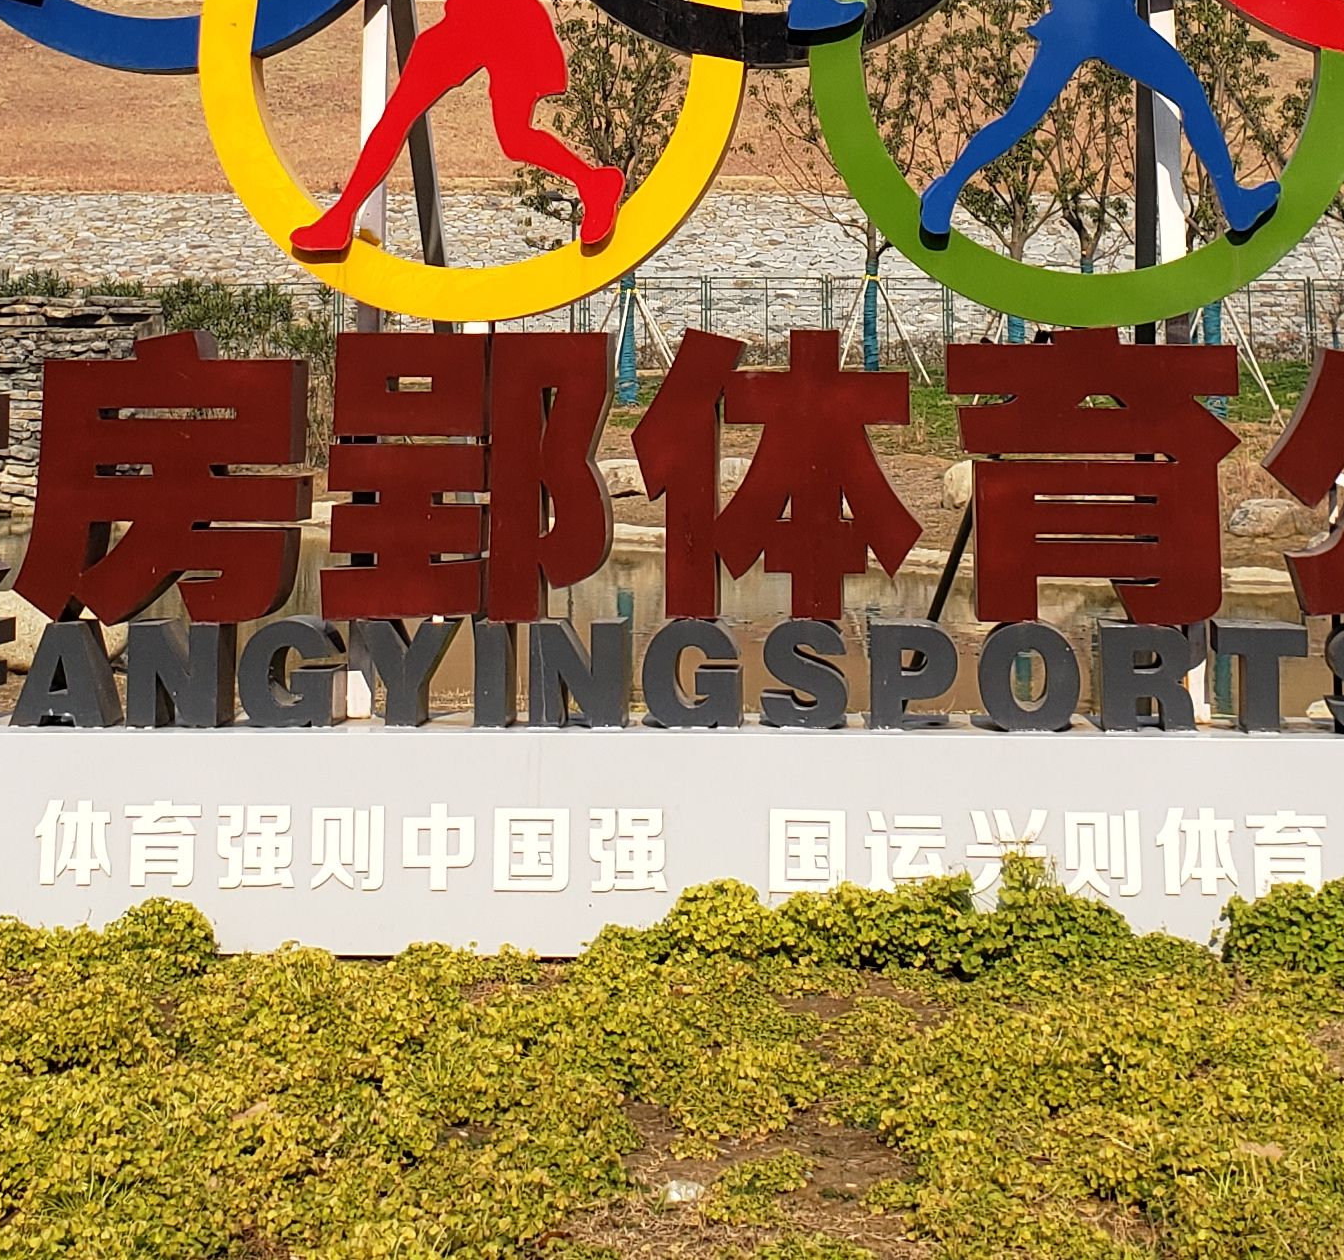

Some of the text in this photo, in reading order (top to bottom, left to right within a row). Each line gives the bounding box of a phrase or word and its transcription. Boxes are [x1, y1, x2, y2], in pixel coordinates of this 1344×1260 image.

[34, 799, 669, 893] 体育强则中国强
